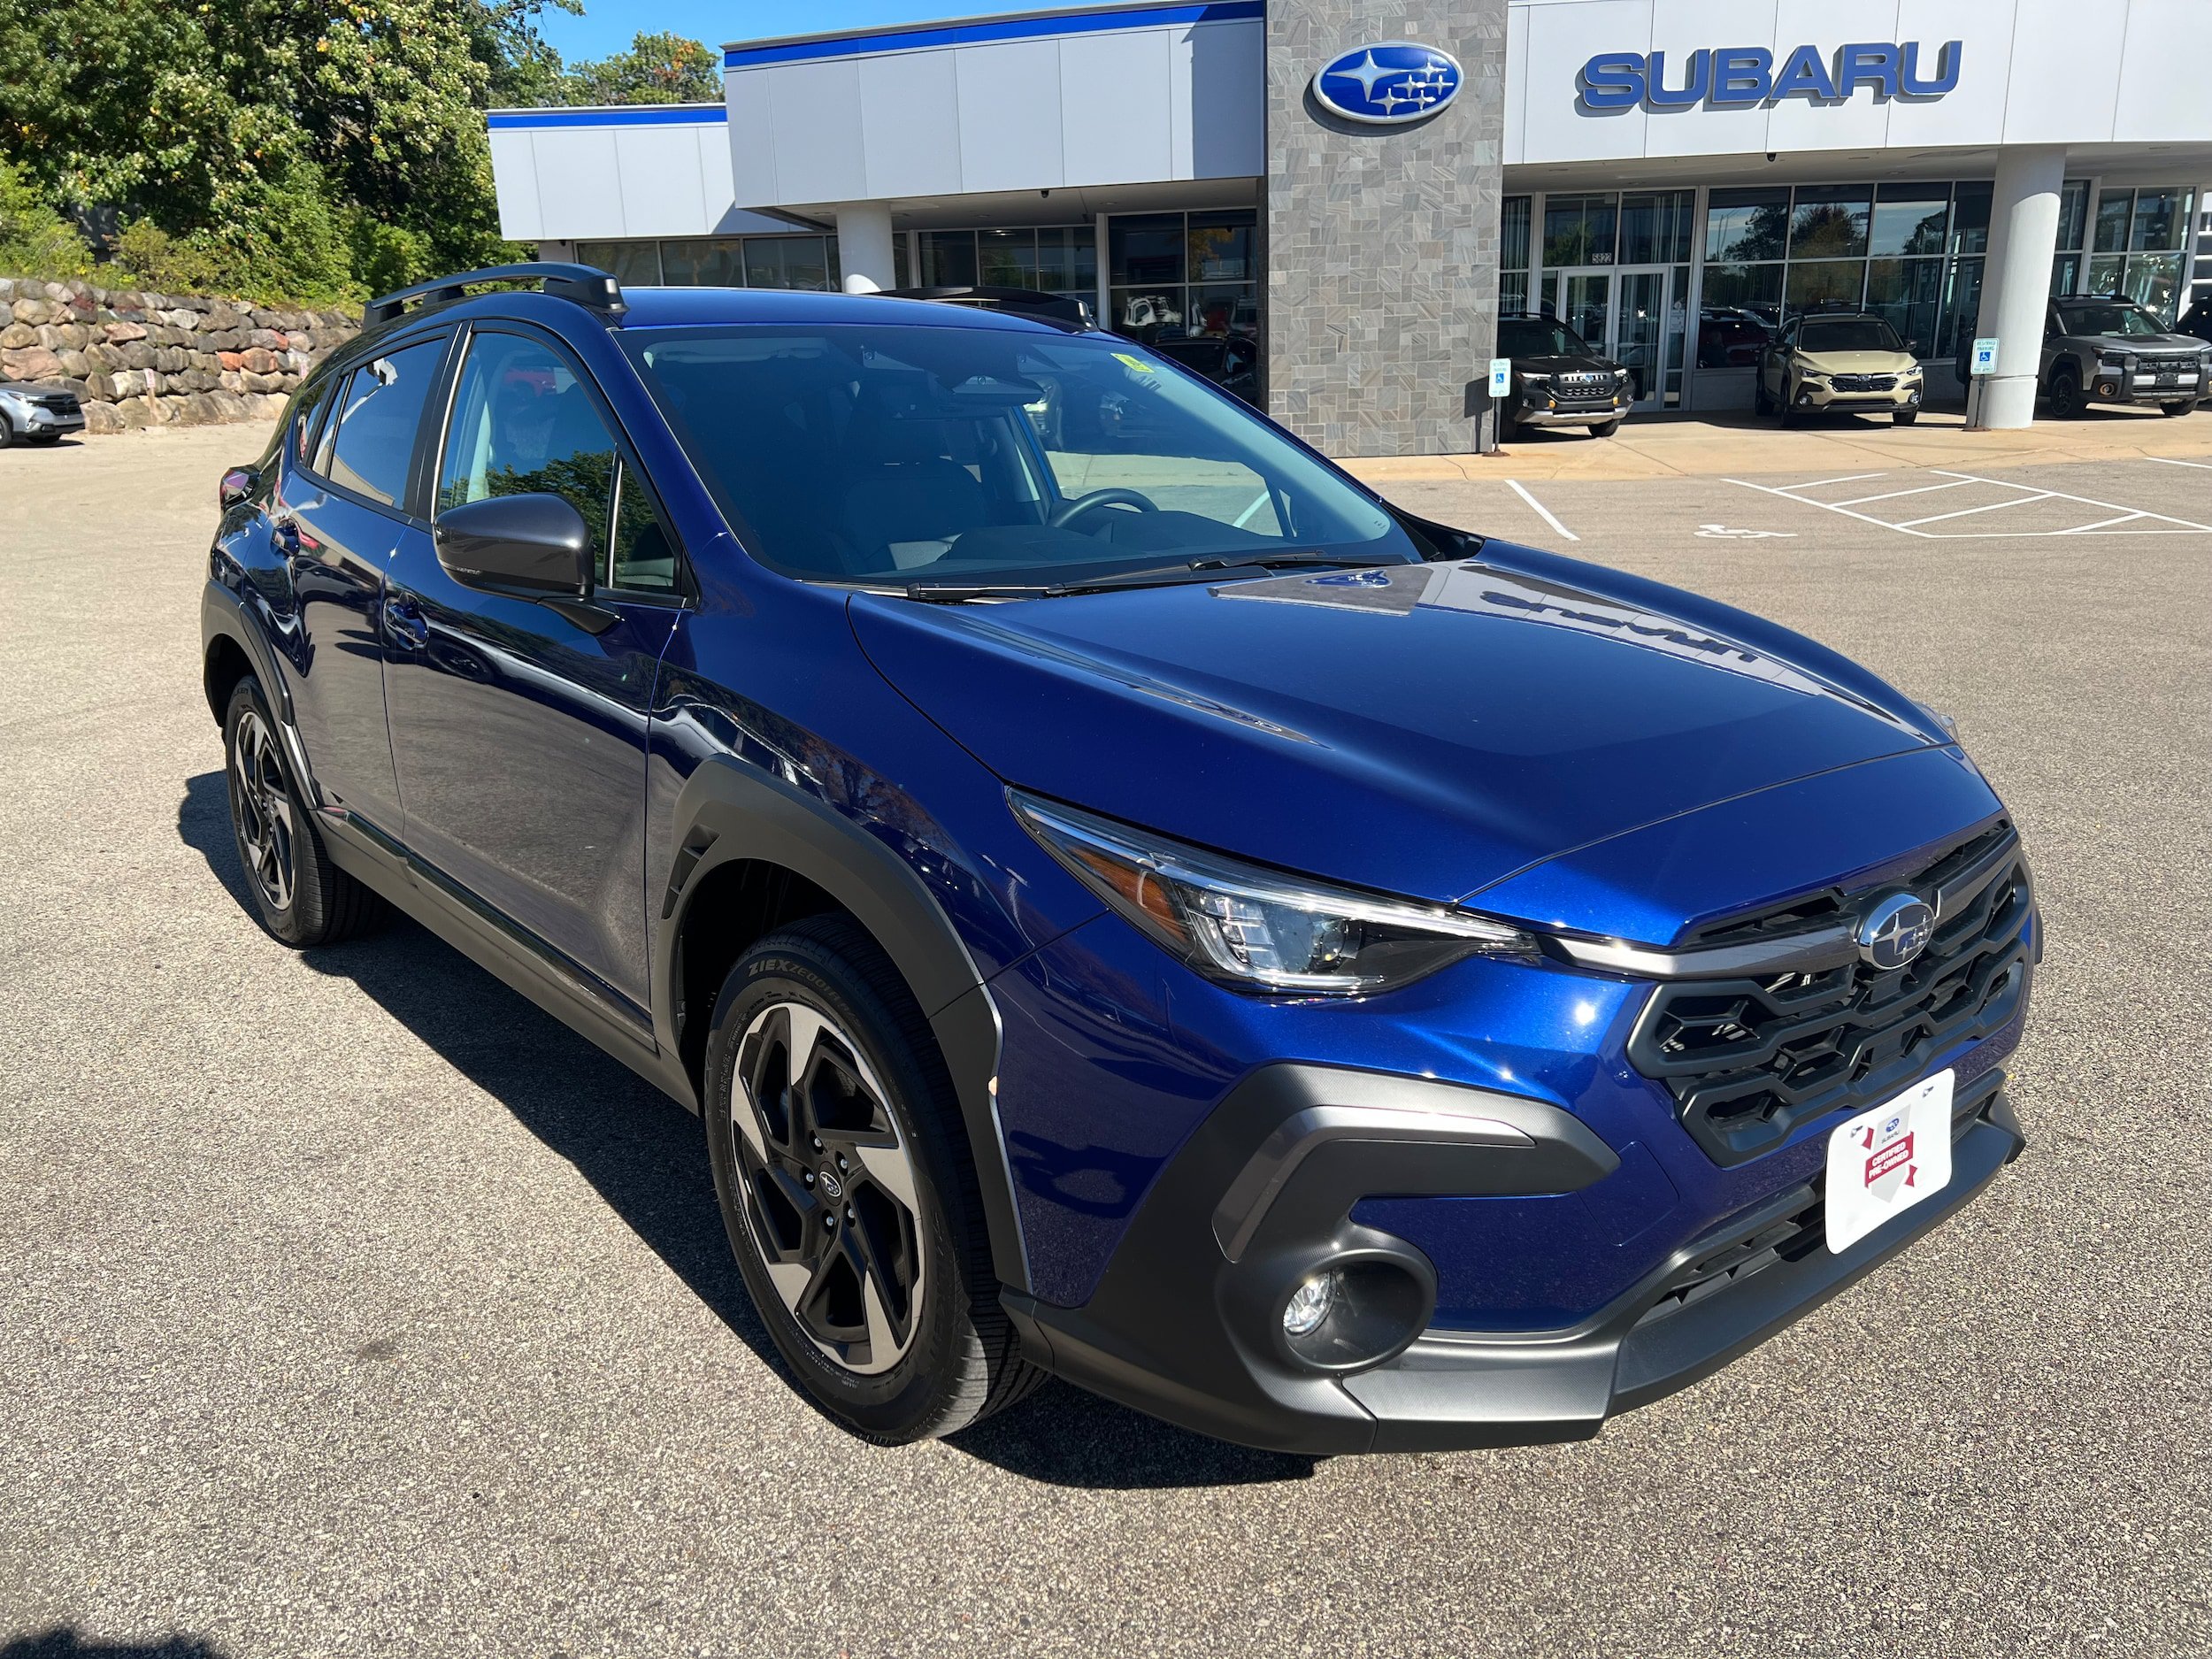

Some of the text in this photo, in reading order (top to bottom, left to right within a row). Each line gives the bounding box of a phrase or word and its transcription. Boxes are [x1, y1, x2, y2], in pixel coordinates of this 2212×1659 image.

[1583, 41, 1962, 108] SUBARU
[749, 958, 791, 978] ZIEX
[1869, 1149, 1909, 1179] PRE-OWNED
[1871, 1142, 1906, 1166] CERTIFIED
